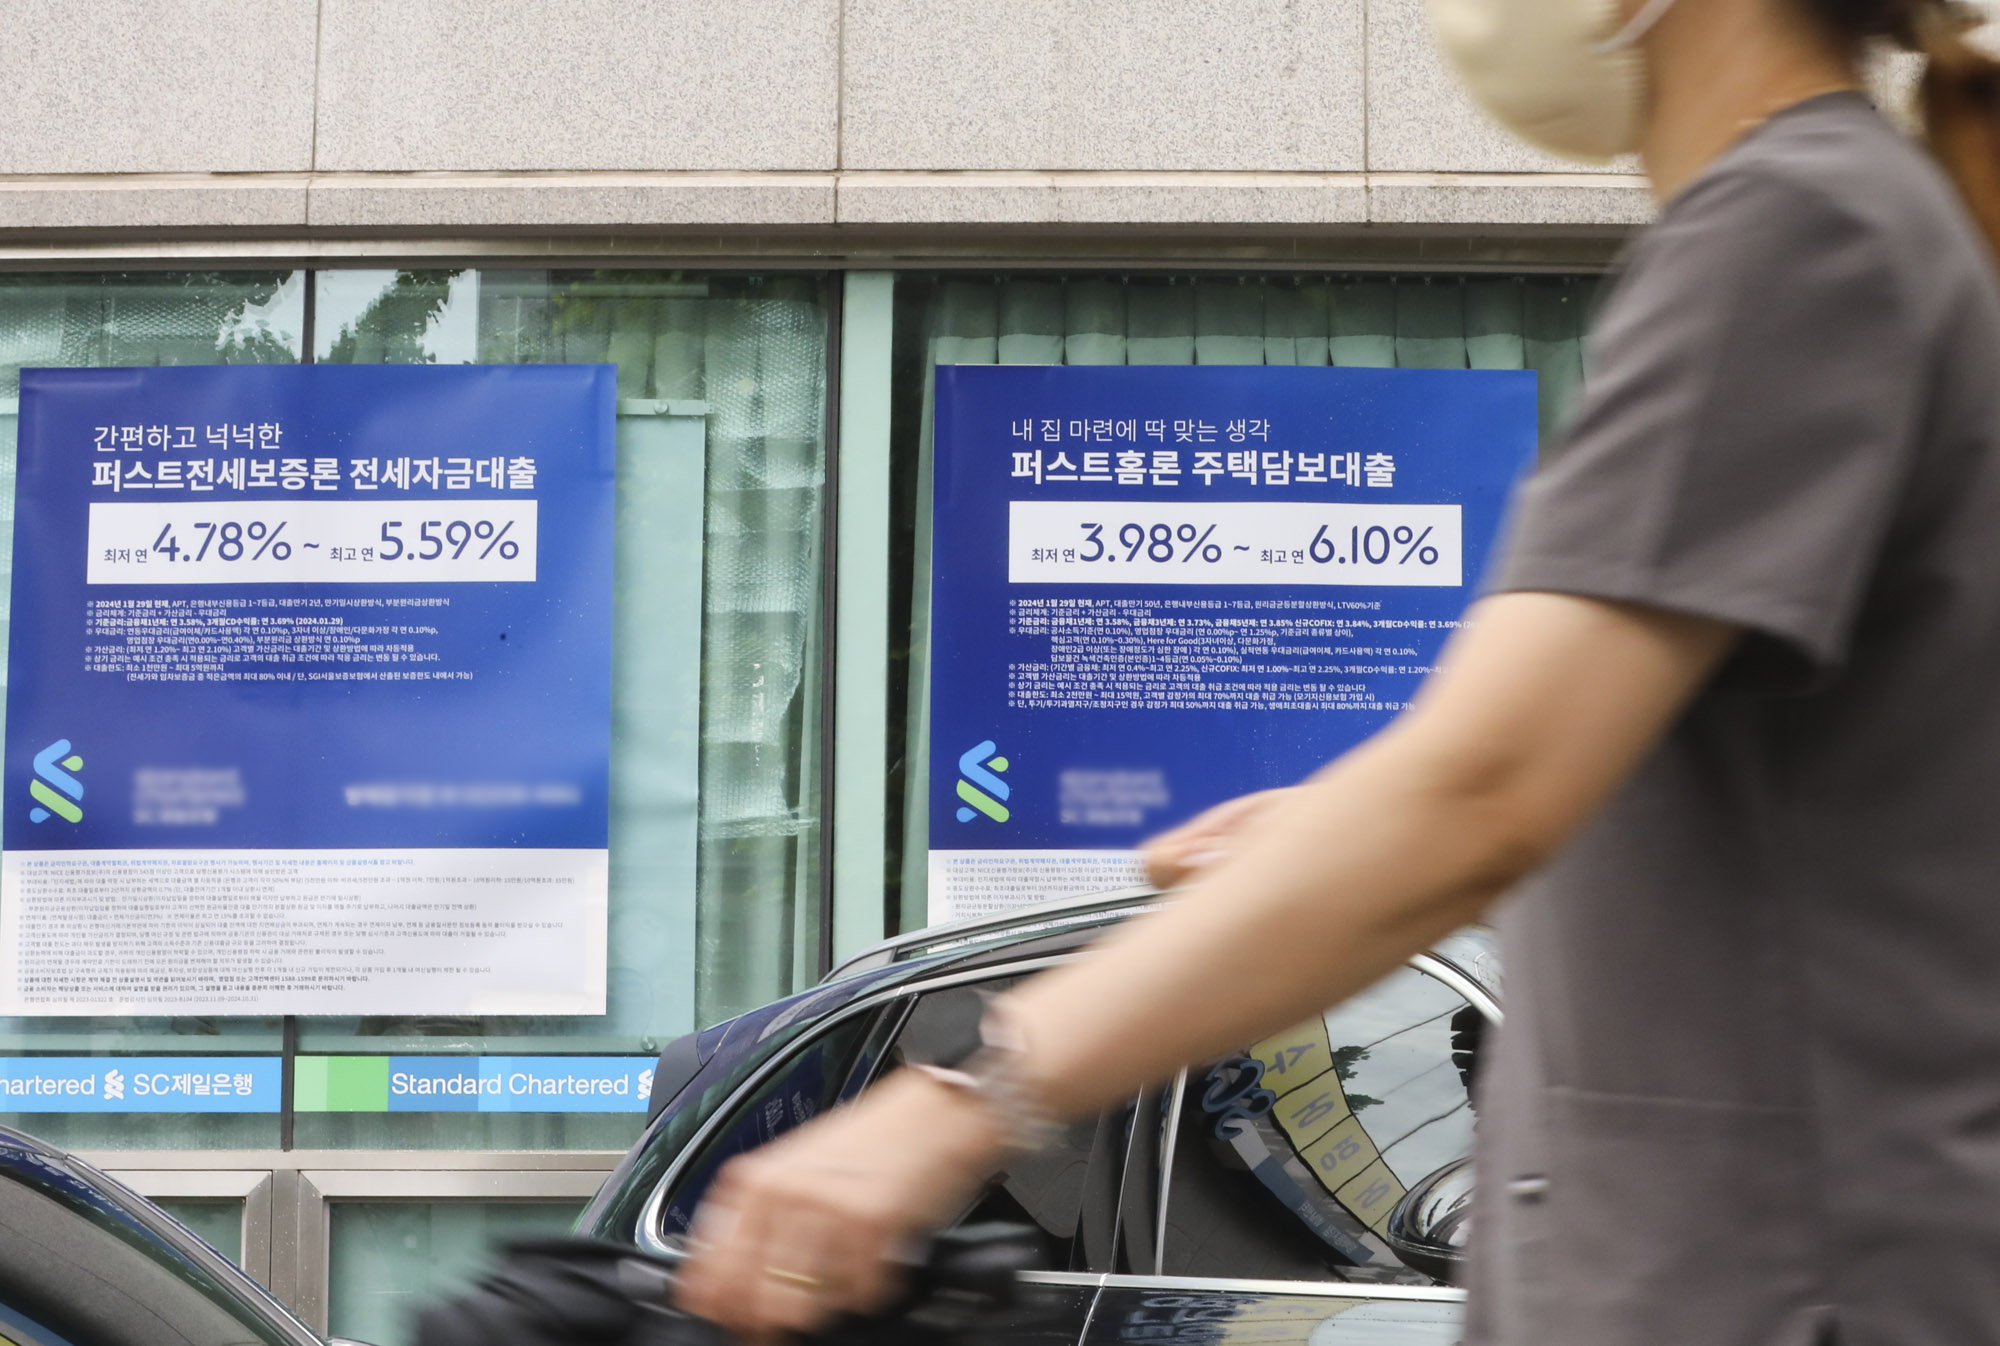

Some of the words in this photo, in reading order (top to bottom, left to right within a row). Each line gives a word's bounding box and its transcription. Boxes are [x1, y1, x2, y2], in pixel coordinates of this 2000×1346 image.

[93, 424, 197, 452] 간편하고
[206, 422, 283, 451] 넉넉한
[1012, 418, 1033, 442] 내
[1040, 418, 1061, 442] 집
[1069, 418, 1137, 443] 마련에
[1145, 418, 1167, 443] 딱
[1173, 418, 1218, 443] 맞는
[1225, 418, 1271, 443] 생각
[91, 457, 341, 493] 퍼스트전세보증론
[349, 455, 538, 491] 전세자금대출
[1010, 449, 1182, 486] 퍼스트홈론
[1191, 449, 1396, 488] 주택담보대출
[104, 548, 131, 564] 최저
[135, 548, 148, 564] 연
[152, 520, 292, 562] 4.78%
[330, 546, 357, 562] 최고
[360, 547, 374, 562] 연
[379, 520, 520, 561] 5.59%
[1031, 547, 1058, 563] 최저
[1062, 548, 1075, 563] 연
[1079, 522, 1222, 564] 3.98%
[1260, 549, 1287, 564] 최고
[1291, 549, 1304, 565] 연
[1309, 524, 1439, 566] 6.10%
[133, 1072, 253, 1096] SC제일은행
[391, 1072, 502, 1095] Standard
[508, 1072, 629, 1095] Chartered
